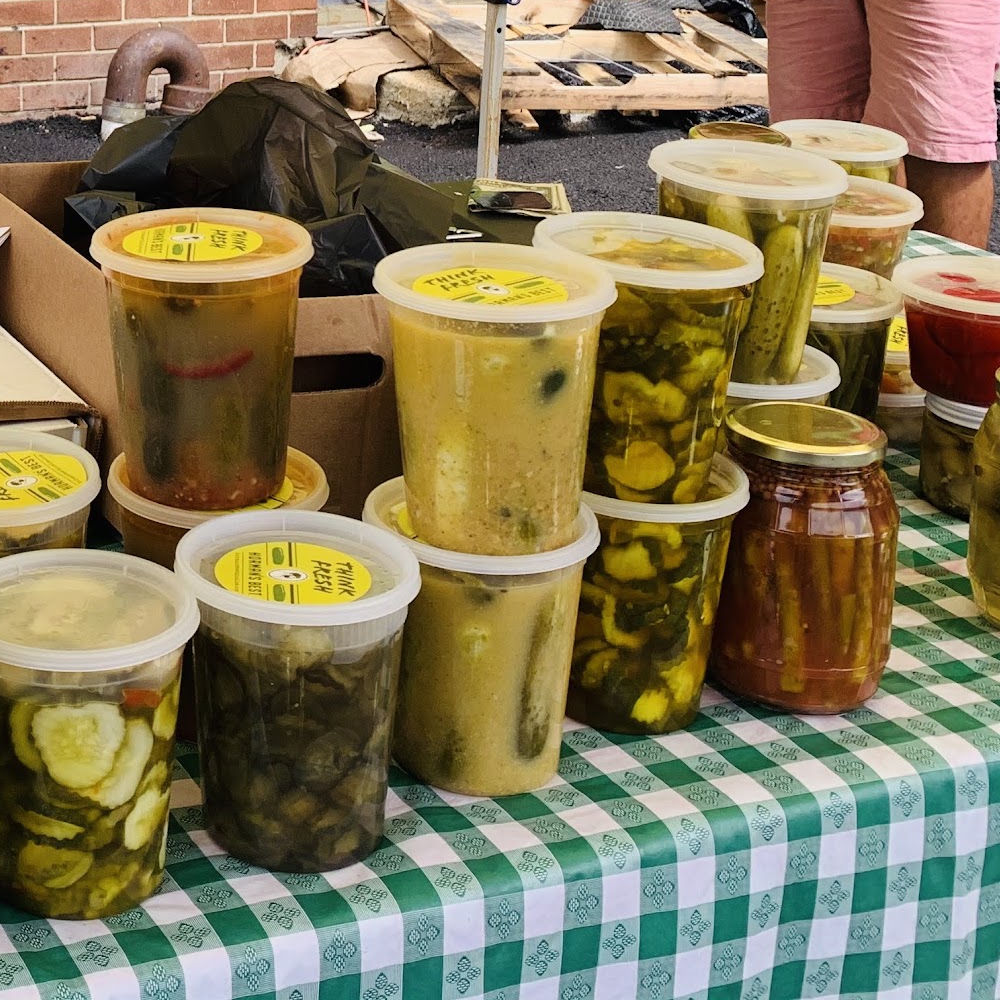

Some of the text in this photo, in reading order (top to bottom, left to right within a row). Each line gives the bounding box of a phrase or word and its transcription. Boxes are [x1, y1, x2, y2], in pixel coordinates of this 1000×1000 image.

[423, 269, 484, 286] THINK
[440, 274, 494, 291] FRESH
[311, 559, 333, 593] FRESH
[334, 562, 356, 597] THINK
